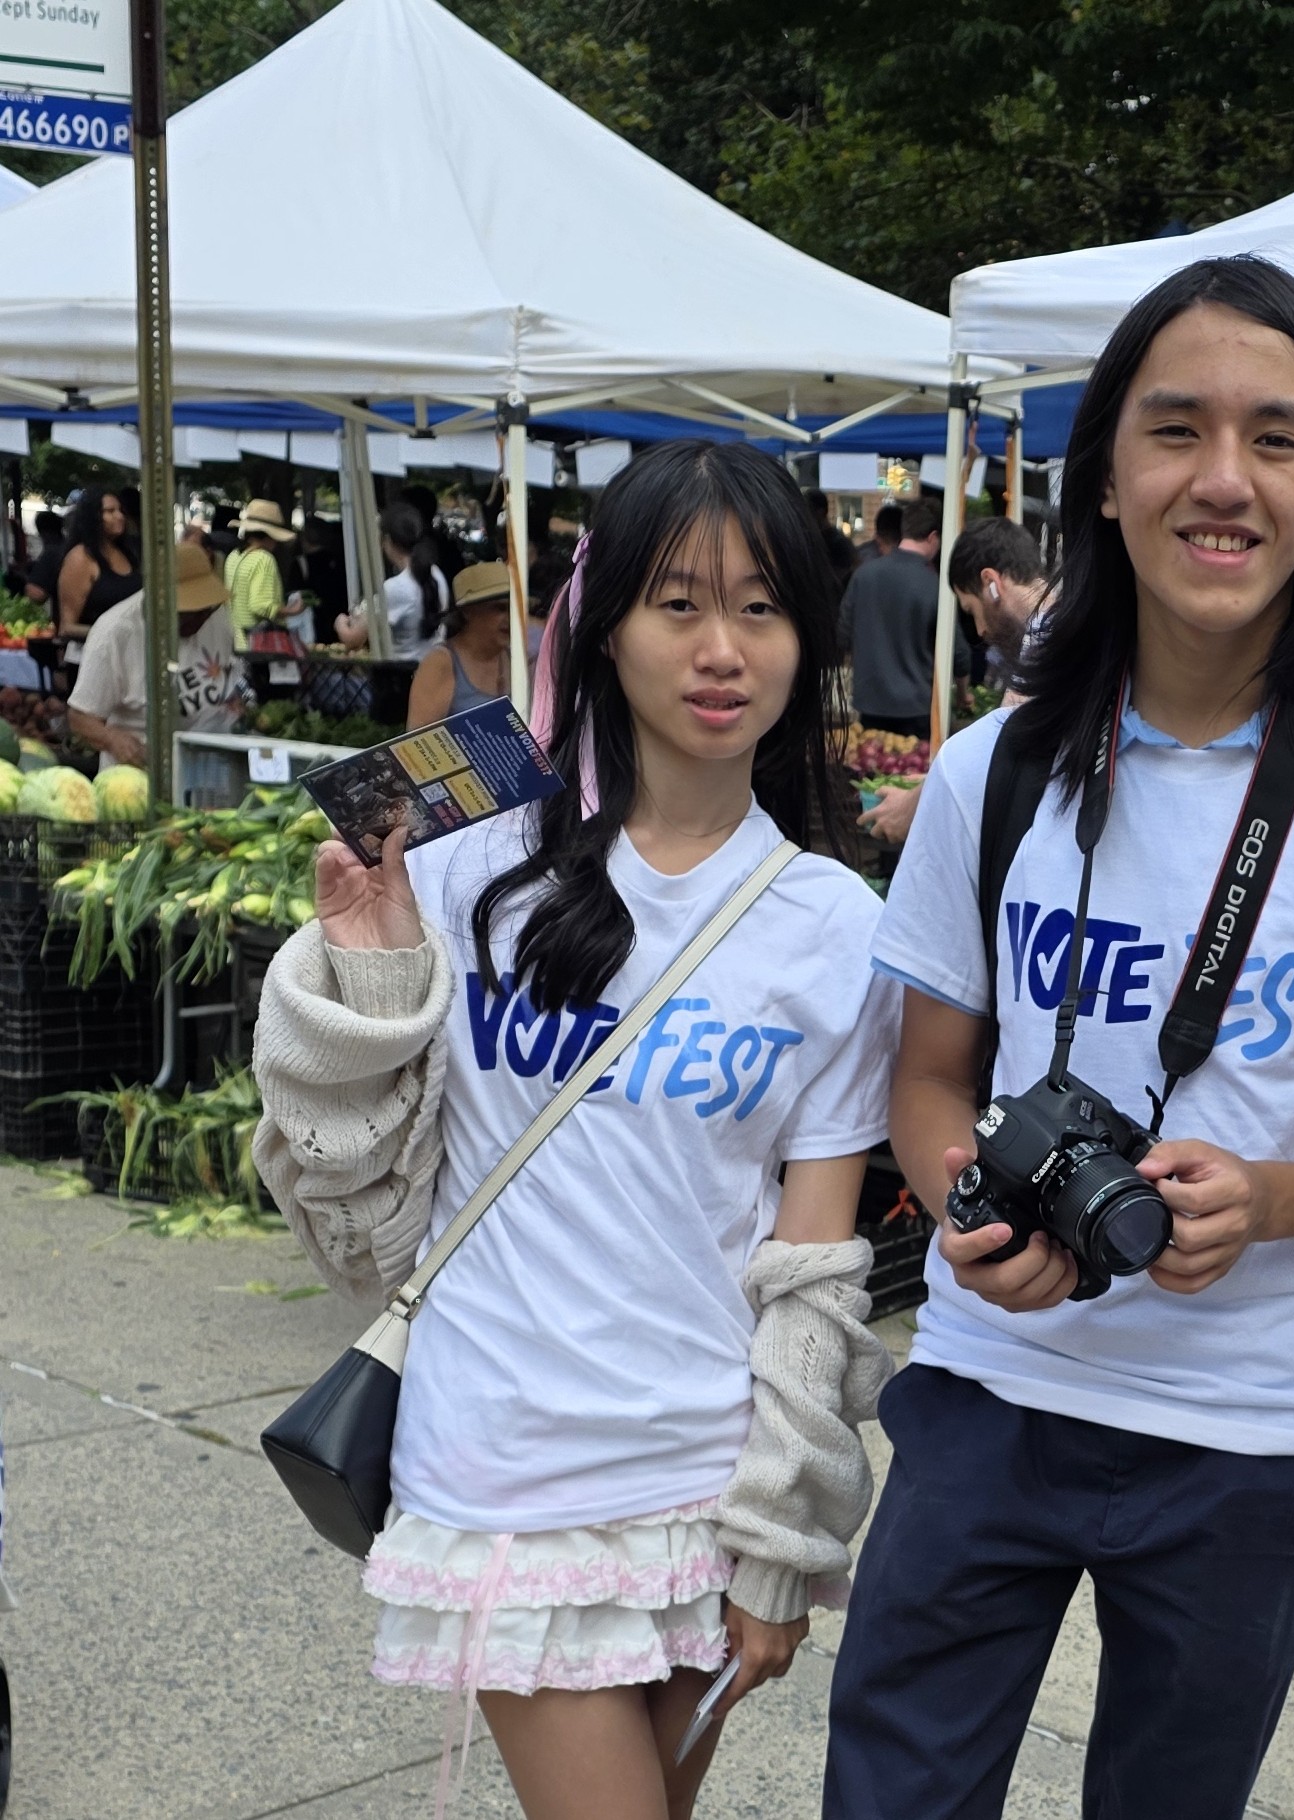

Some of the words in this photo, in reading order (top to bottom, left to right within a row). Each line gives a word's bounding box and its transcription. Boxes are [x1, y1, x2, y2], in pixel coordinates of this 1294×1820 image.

[0, 0, 31, 19] ept
[37, 0, 101, 29] Sunday
[0, 106, 109, 150] 466690
[505, 712, 526, 733] WHY
[1236, 818, 1270, 878] EOS
[1196, 884, 1248, 992] DIGITAL
[625, 997, 805, 1122] FEST
[1031, 1150, 1059, 1184] Canon
